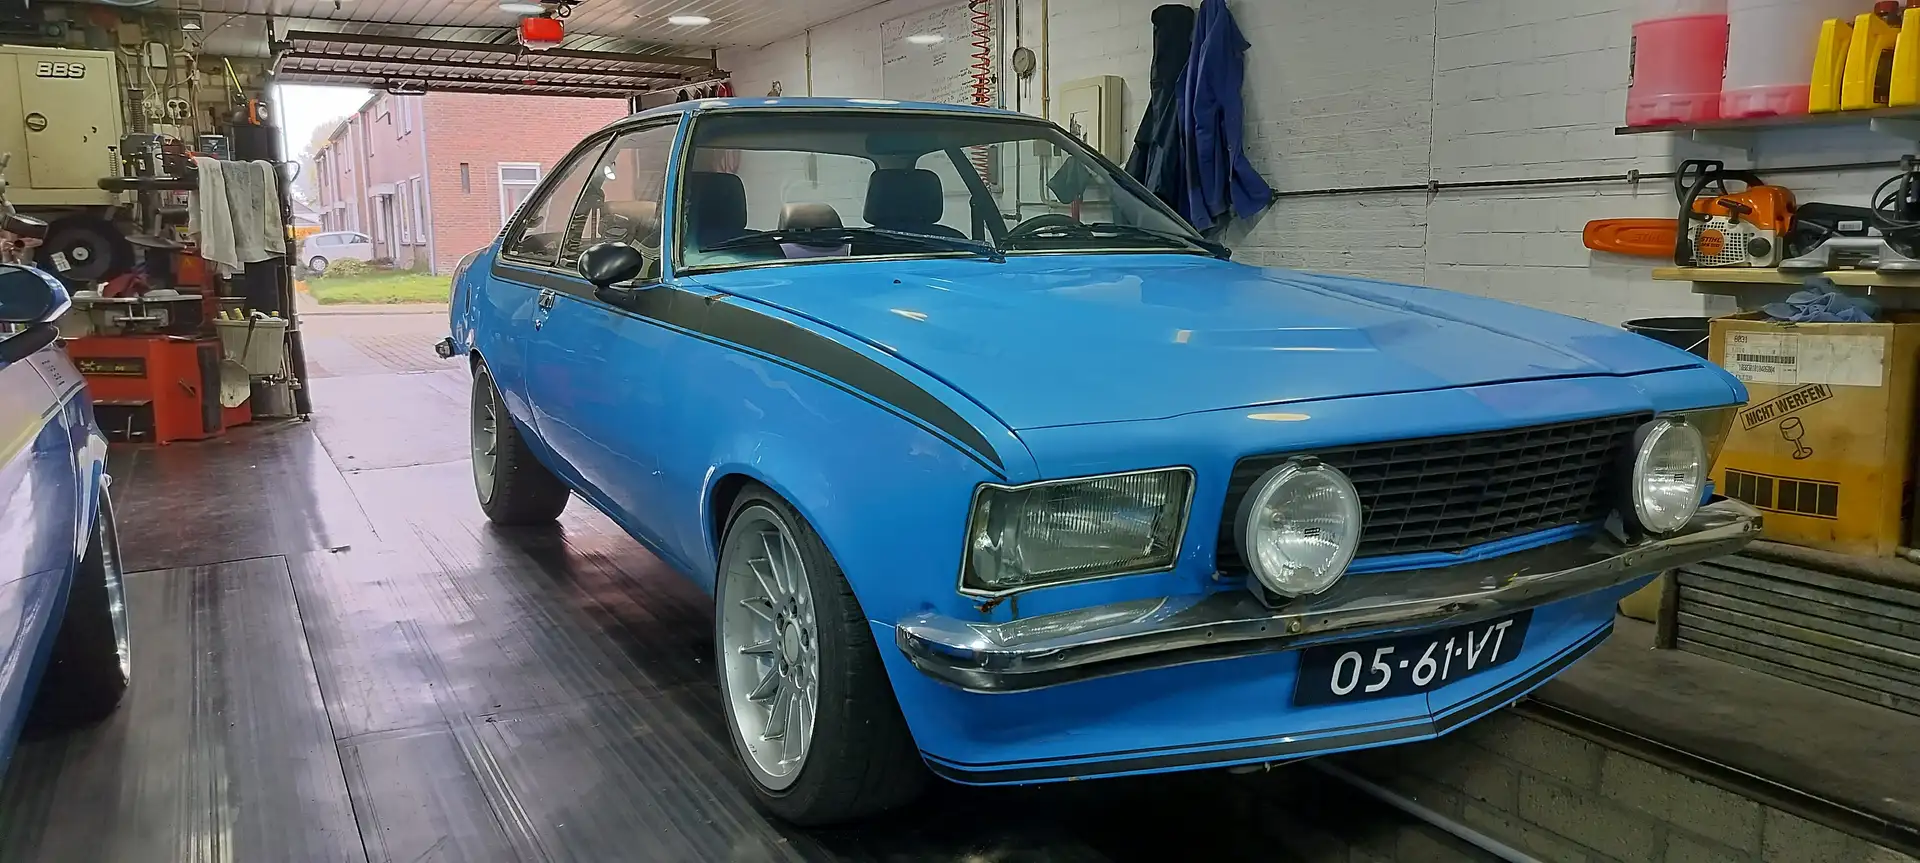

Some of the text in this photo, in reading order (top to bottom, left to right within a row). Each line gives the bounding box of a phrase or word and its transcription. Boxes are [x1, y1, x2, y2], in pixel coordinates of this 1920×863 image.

[36, 61, 85, 78] BBS
[1745, 384, 1827, 426] NICHT WERFEN
[1330, 619, 1513, 695] 05-61-VT
